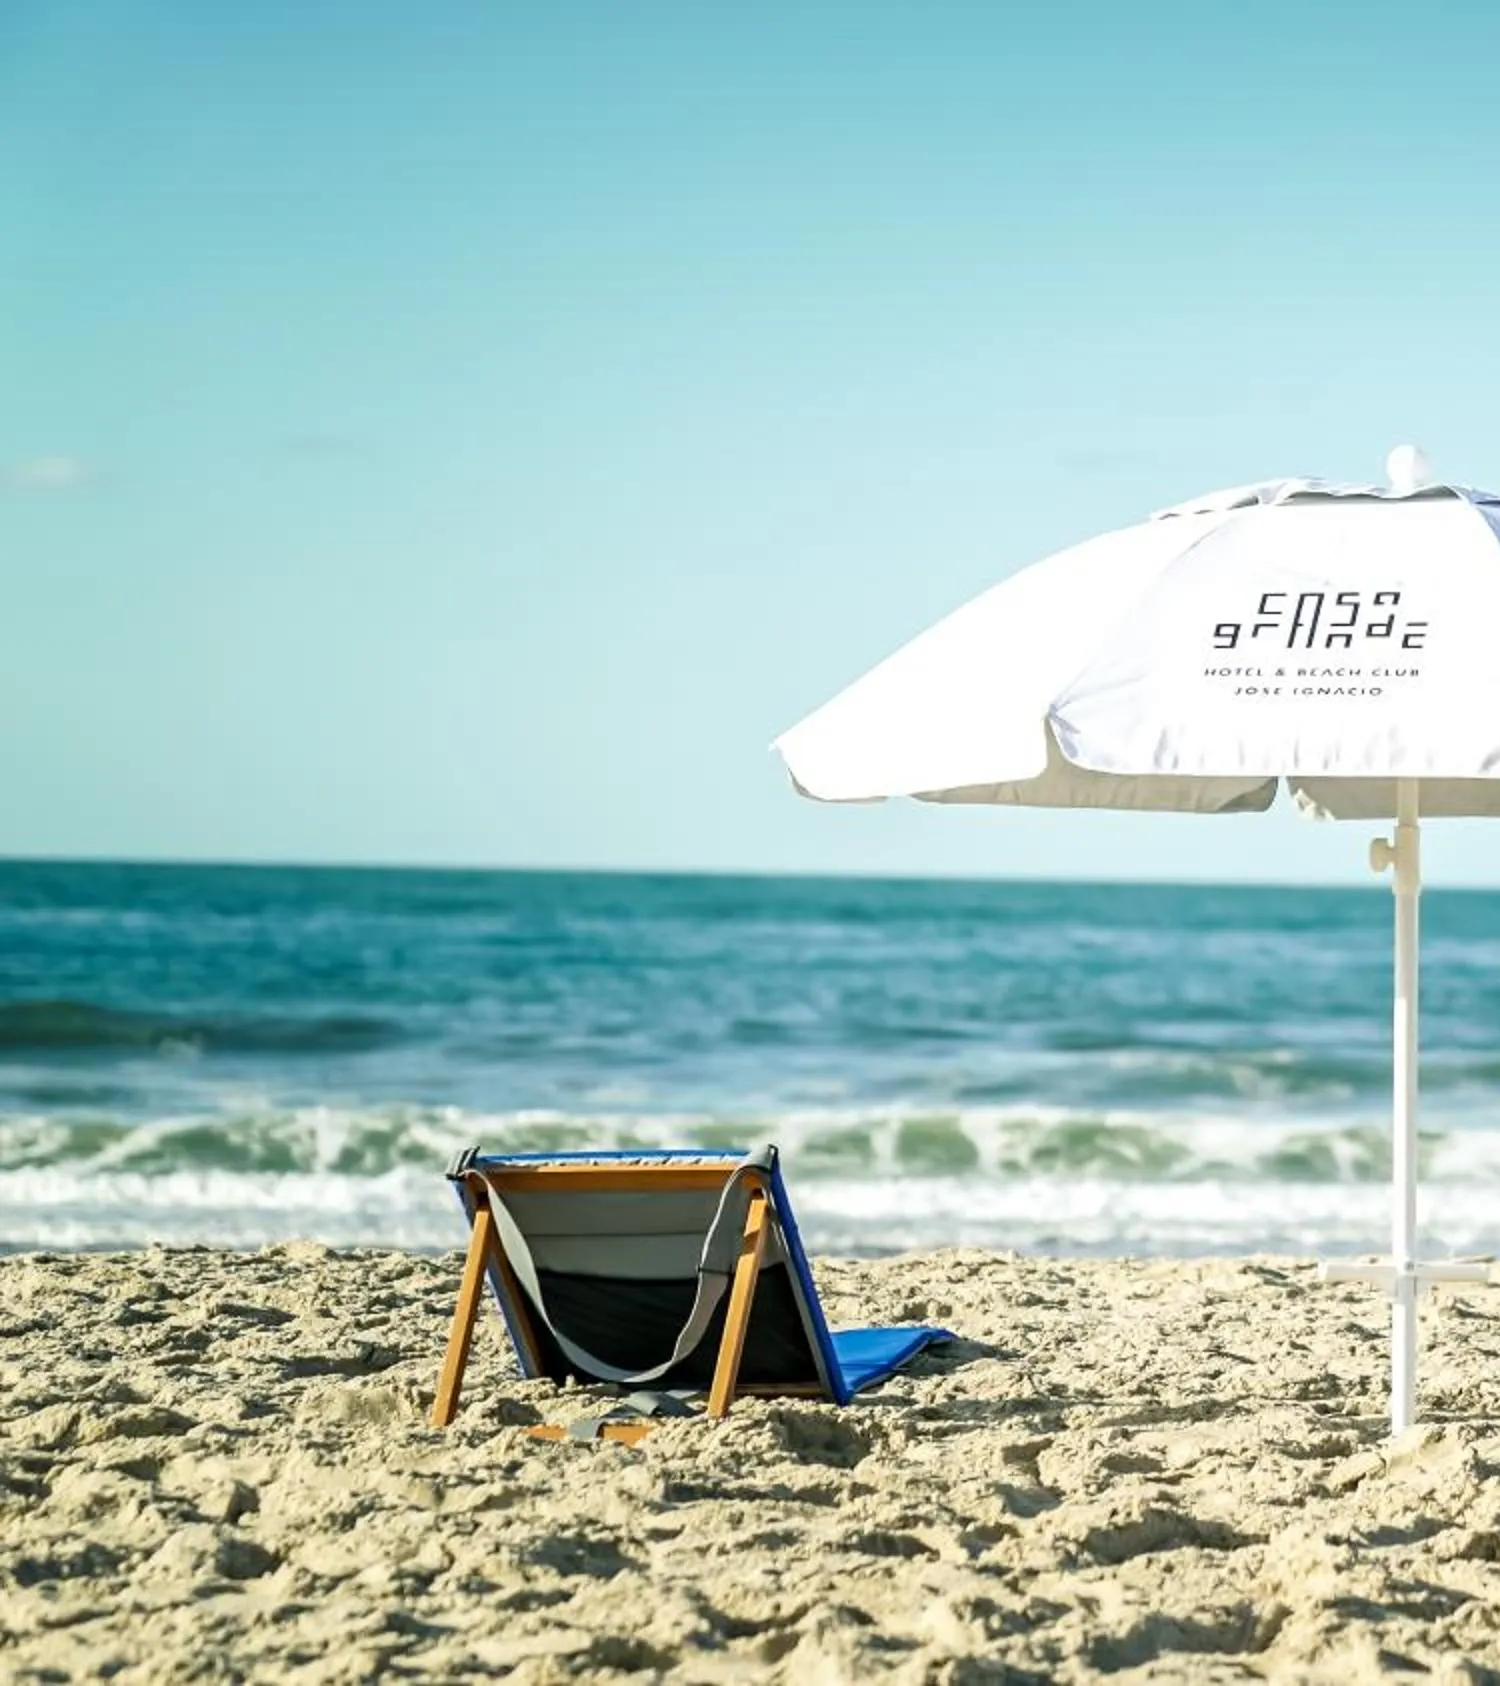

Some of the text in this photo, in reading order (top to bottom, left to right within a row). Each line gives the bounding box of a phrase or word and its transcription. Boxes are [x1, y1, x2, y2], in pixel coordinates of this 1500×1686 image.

[1203, 667, 1420, 677] HOTEL & BEACH CLUB
[1292, 686, 1384, 697] IGNACIO
